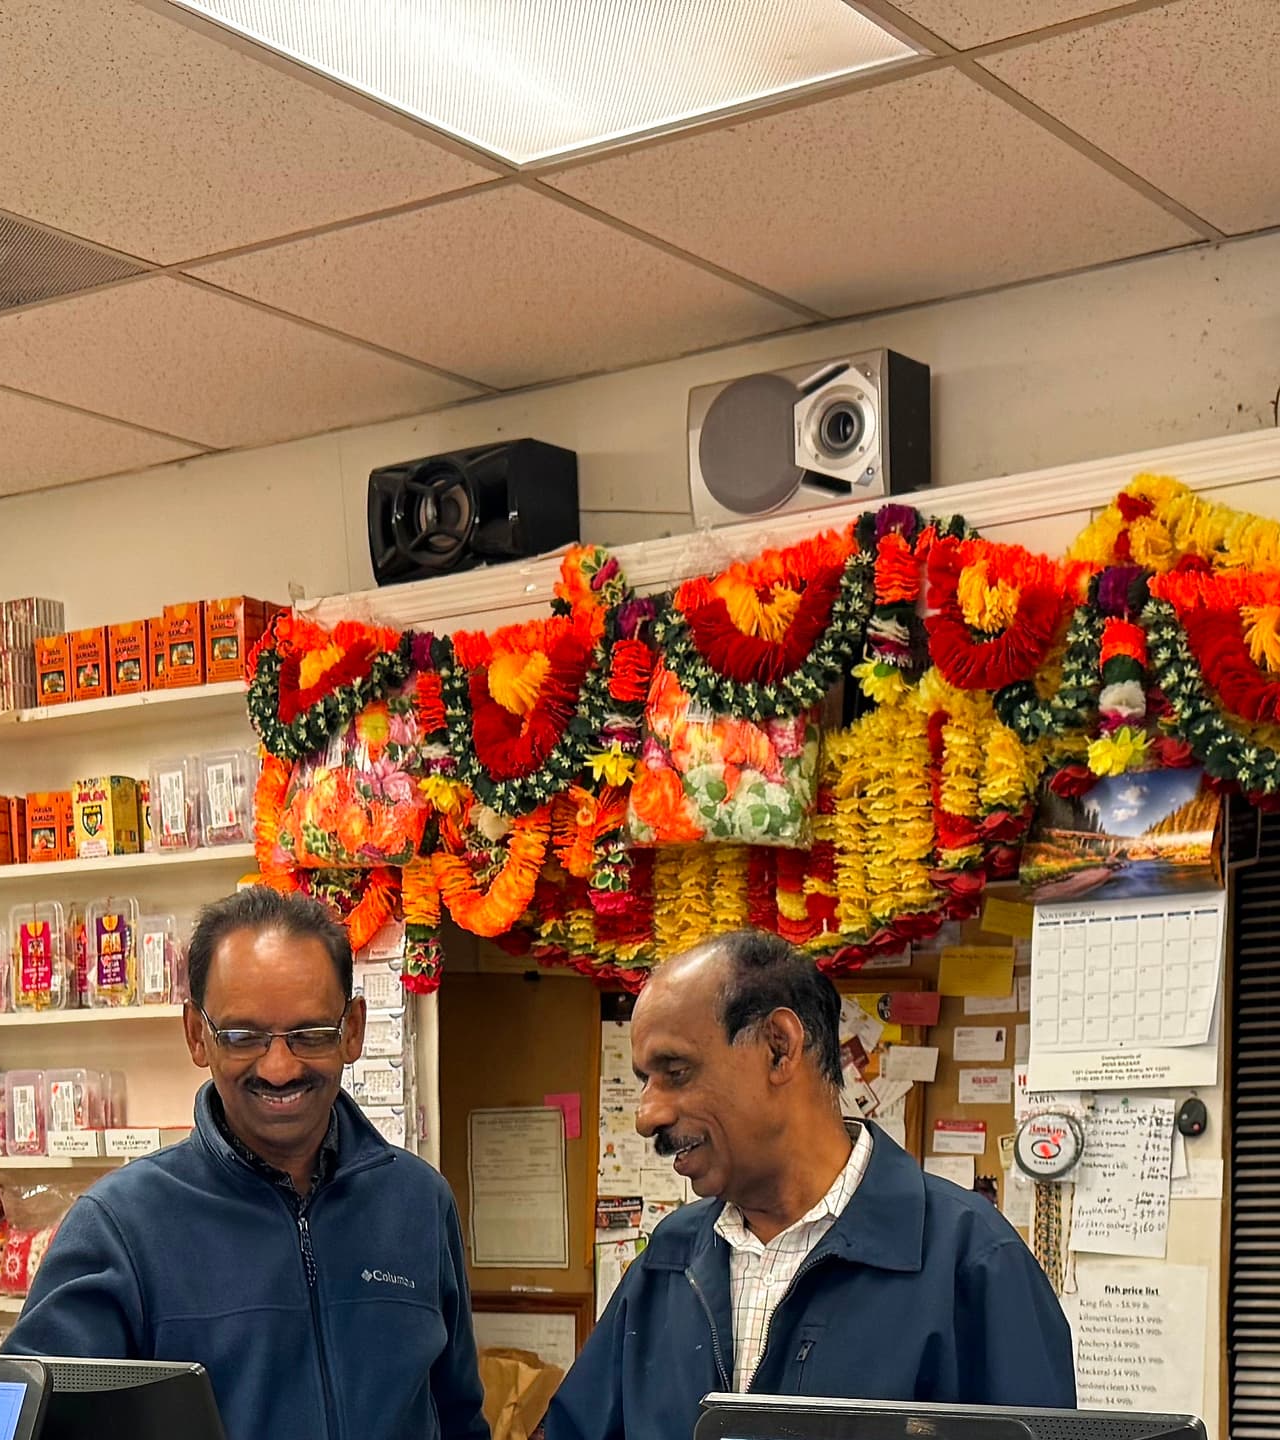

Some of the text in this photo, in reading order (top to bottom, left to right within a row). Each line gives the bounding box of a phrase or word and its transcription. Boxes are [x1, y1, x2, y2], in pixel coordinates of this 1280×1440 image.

[1028, 1096, 1056, 1104] PARTS
[1105, 1285, 1159, 1296] fish price list
